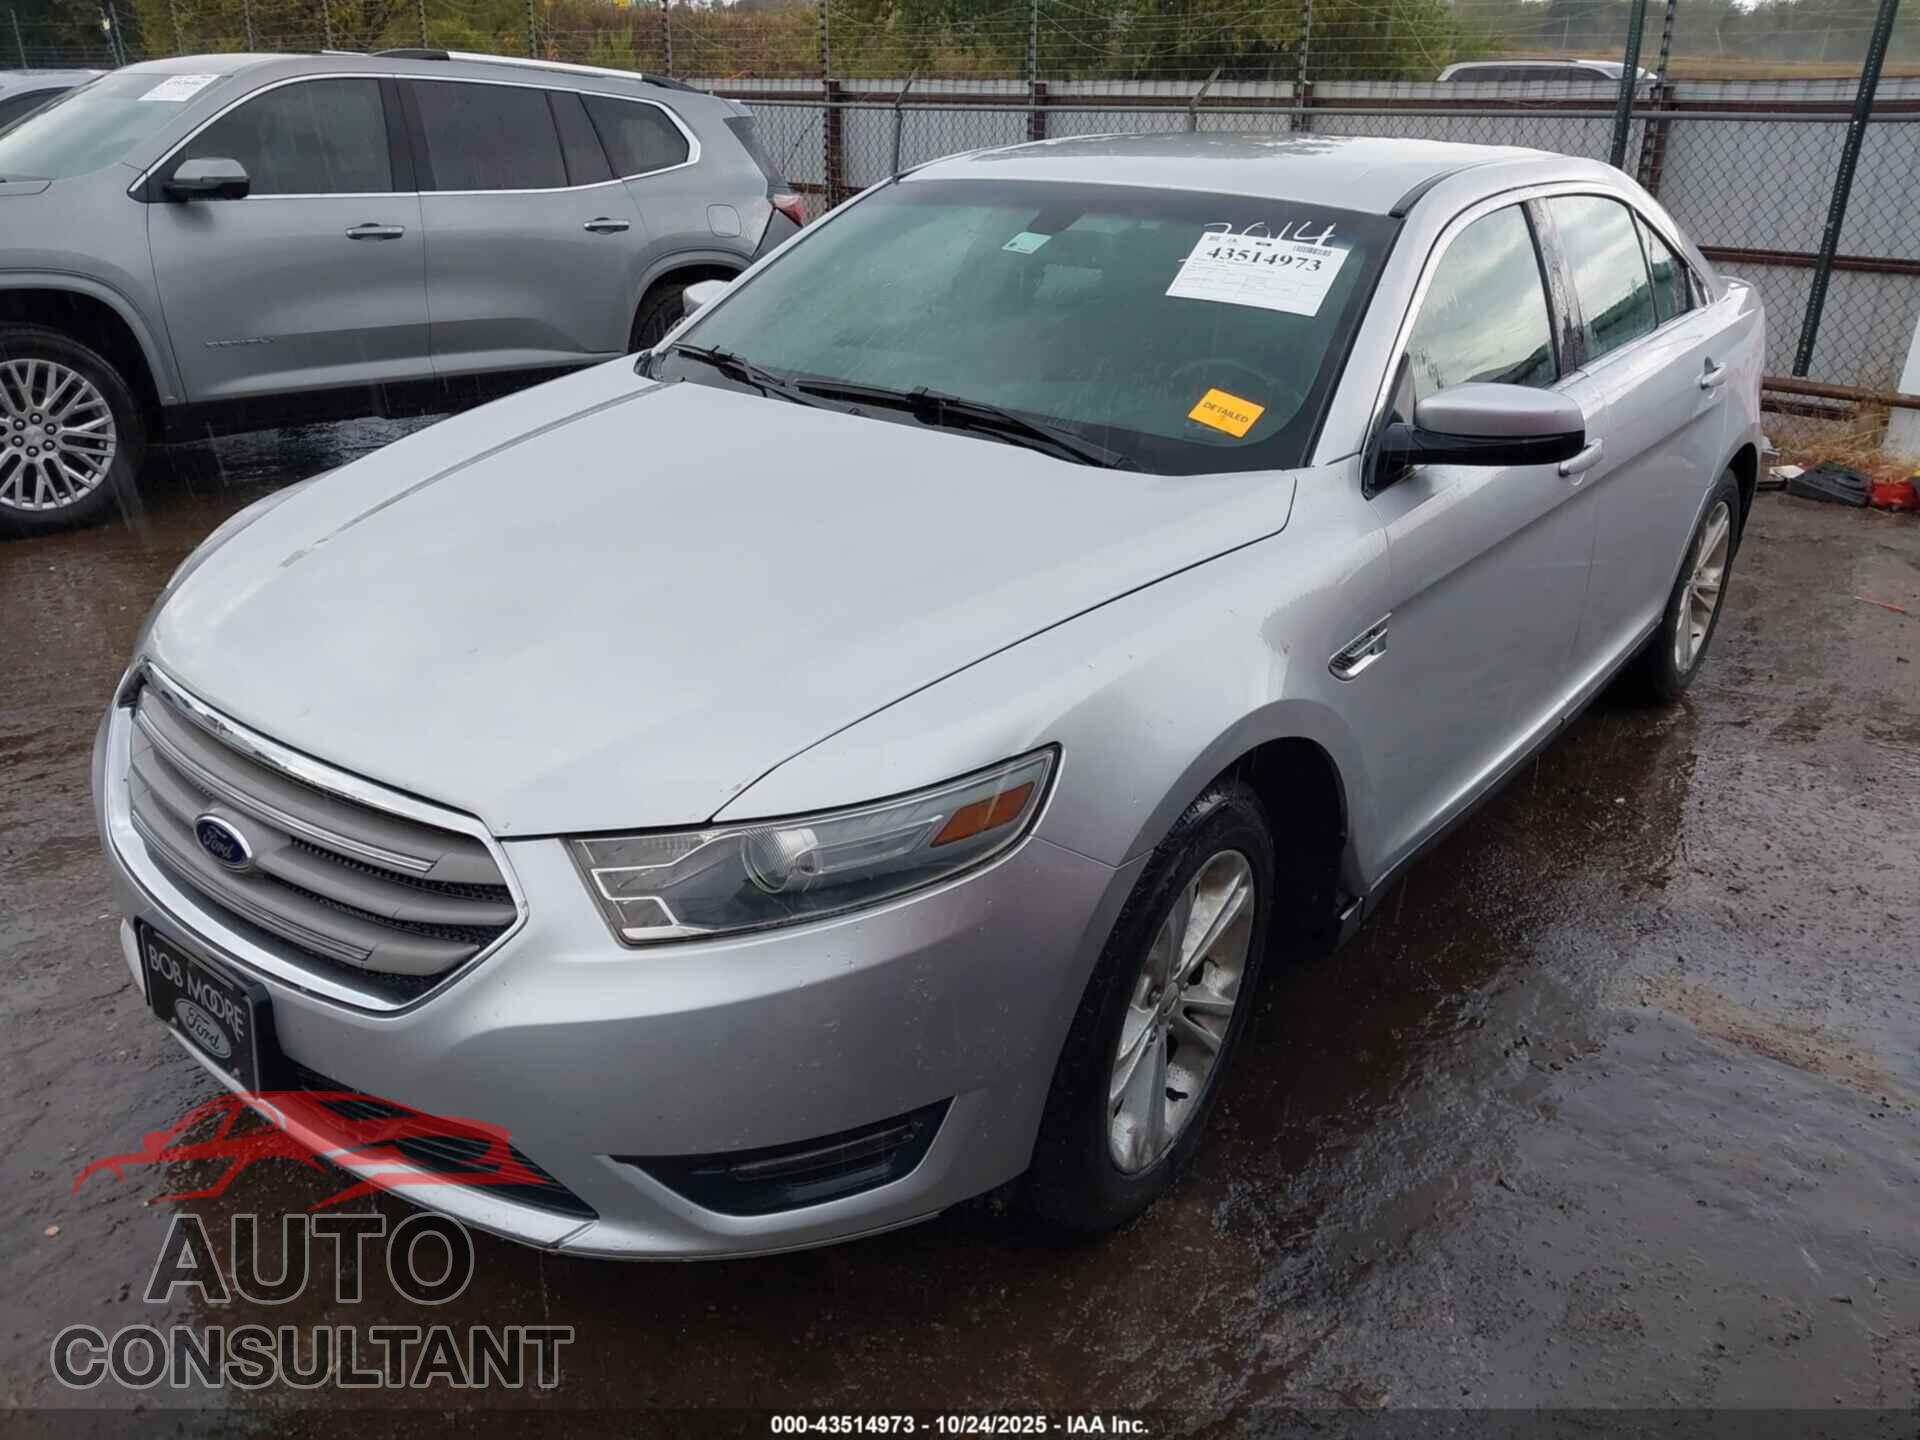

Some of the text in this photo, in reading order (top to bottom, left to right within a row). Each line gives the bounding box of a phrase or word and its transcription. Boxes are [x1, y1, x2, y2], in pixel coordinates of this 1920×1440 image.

[1207, 247, 1322, 272] 43514973
[1203, 401, 1249, 424] DETAILED
[149, 943, 246, 1043] BOB MOORE
[186, 1006, 221, 1050] Ford
